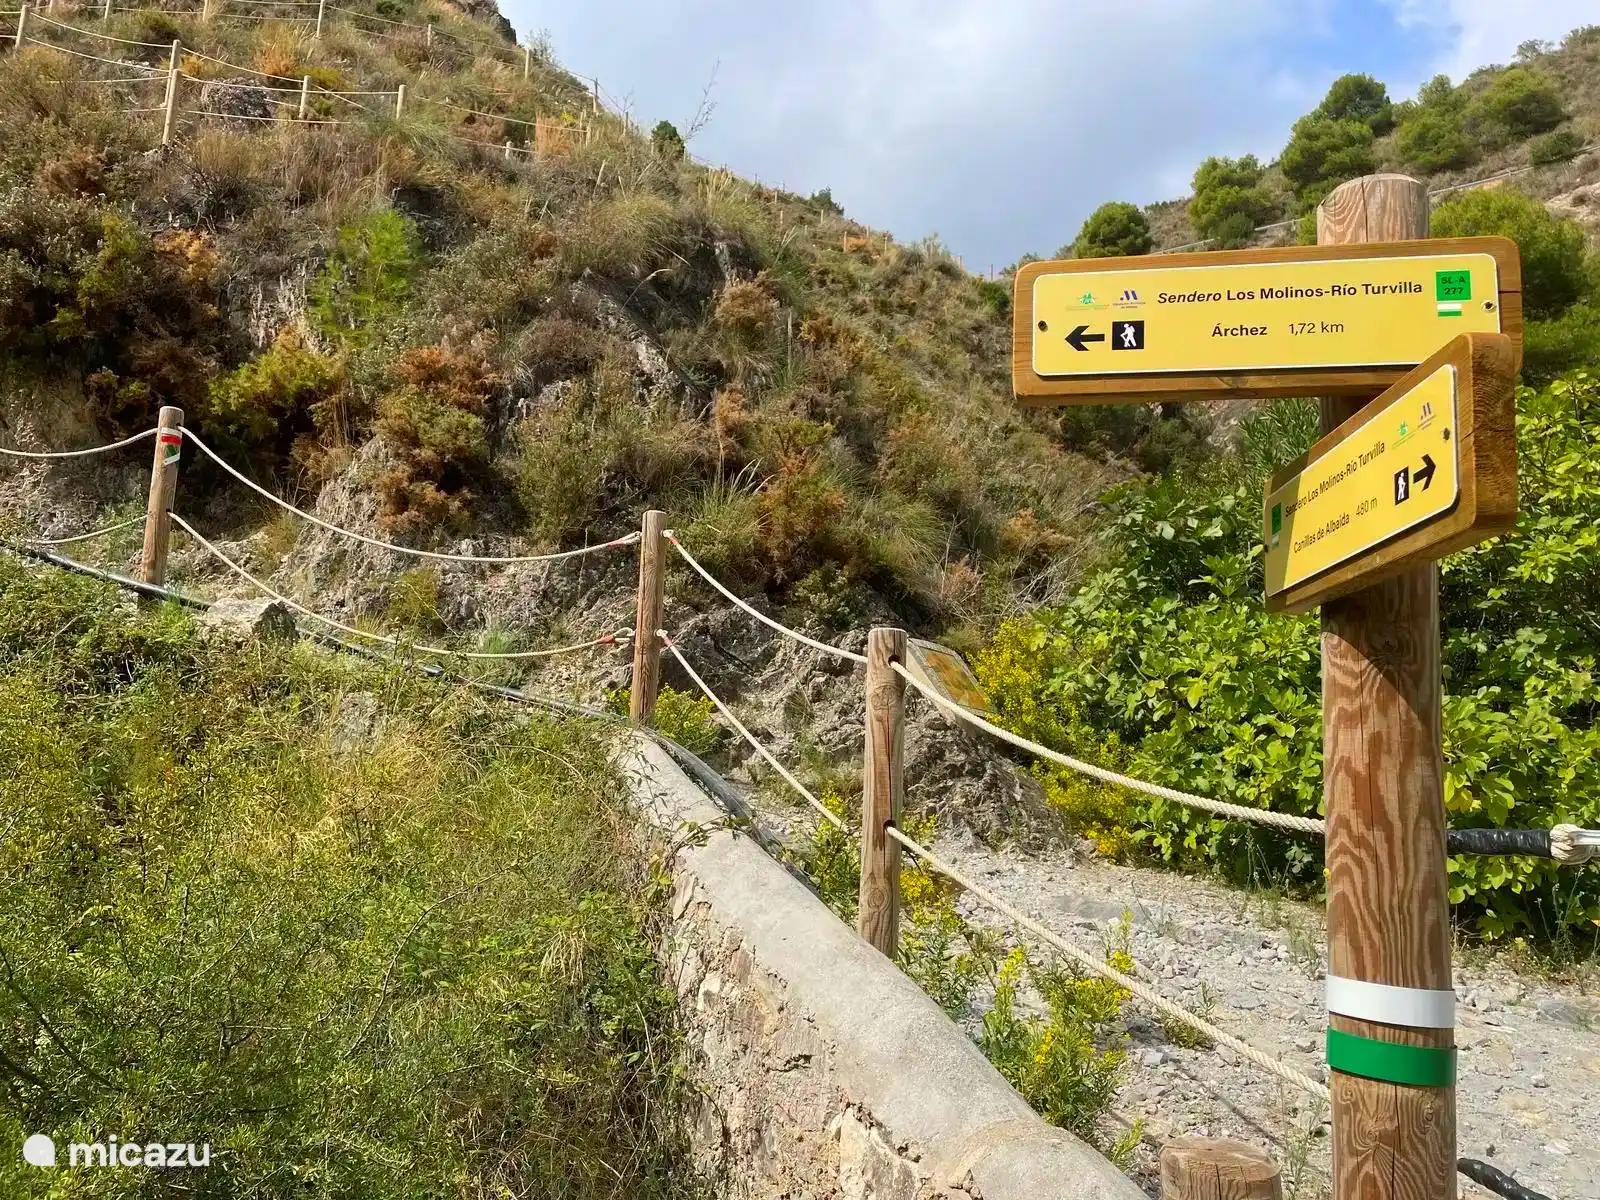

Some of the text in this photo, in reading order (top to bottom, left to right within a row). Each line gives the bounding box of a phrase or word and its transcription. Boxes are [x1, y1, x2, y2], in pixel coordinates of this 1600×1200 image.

[1157, 290, 1222, 305] Sendero
[1226, 289, 1255, 302] Los
[1260, 284, 1357, 300] Molinos-Río
[1361, 281, 1423, 296] Turvilla
[1443, 287, 1464, 296] 277
[1211, 321, 1345, 338] Árchez 1,72 km
[1284, 495, 1308, 518] Sendero
[1307, 487, 1319, 503] Los
[1319, 462, 1358, 494] Molinos-Río
[1358, 441, 1386, 468] Turvilla
[1293, 531, 1317, 554] Canillas
[1316, 526, 1325, 541] de
[1325, 512, 1350, 535] Albaida
[1370, 497, 1378, 512] m
